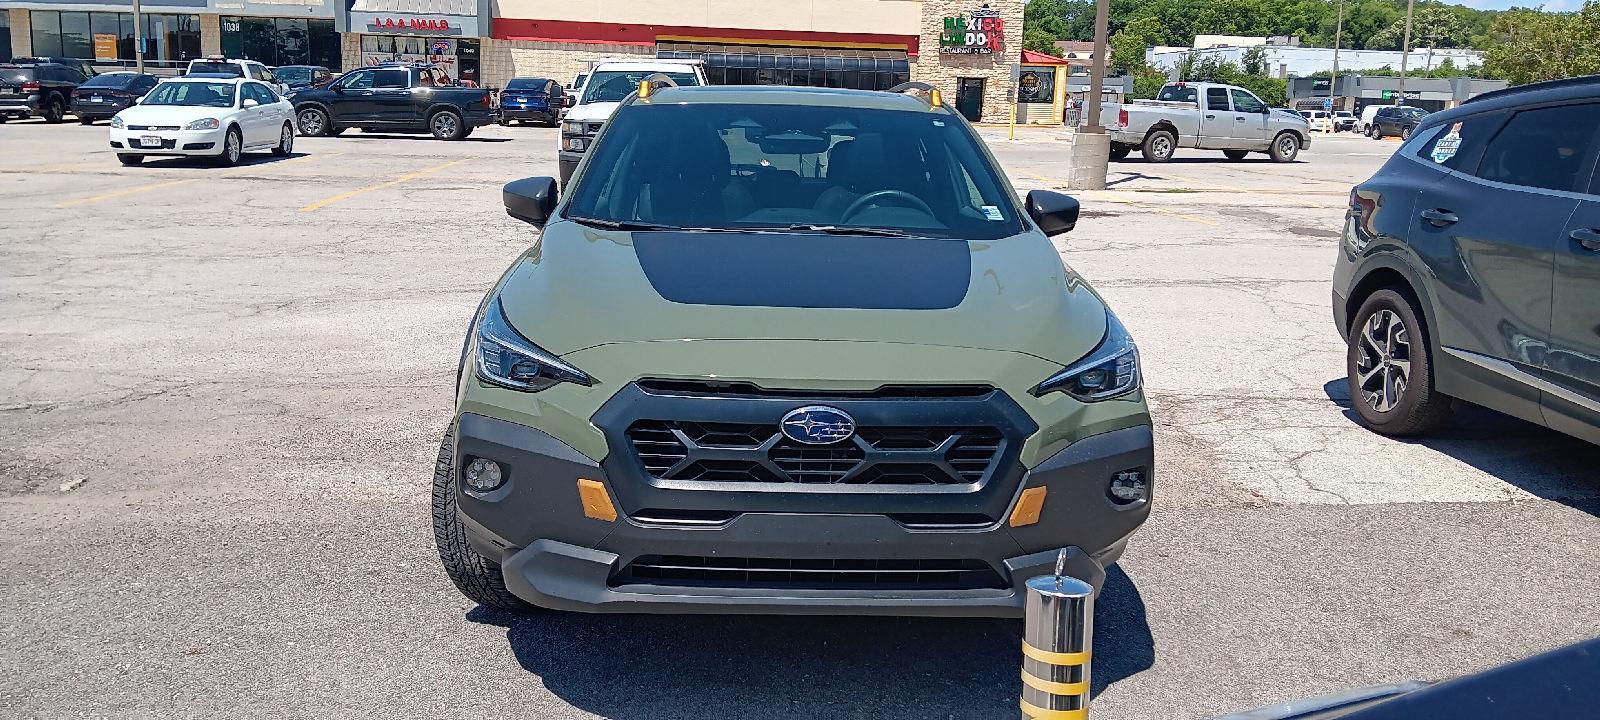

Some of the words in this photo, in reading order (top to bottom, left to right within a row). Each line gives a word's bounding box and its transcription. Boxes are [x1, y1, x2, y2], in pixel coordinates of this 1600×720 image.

[224, 22, 240, 32] 1038
[375, 17, 383, 28] L
[386, 18, 394, 28] &
[398, 19, 406, 28] A
[410, 19, 448, 30] NAILS
[940, 32, 986, 46] LINDO
